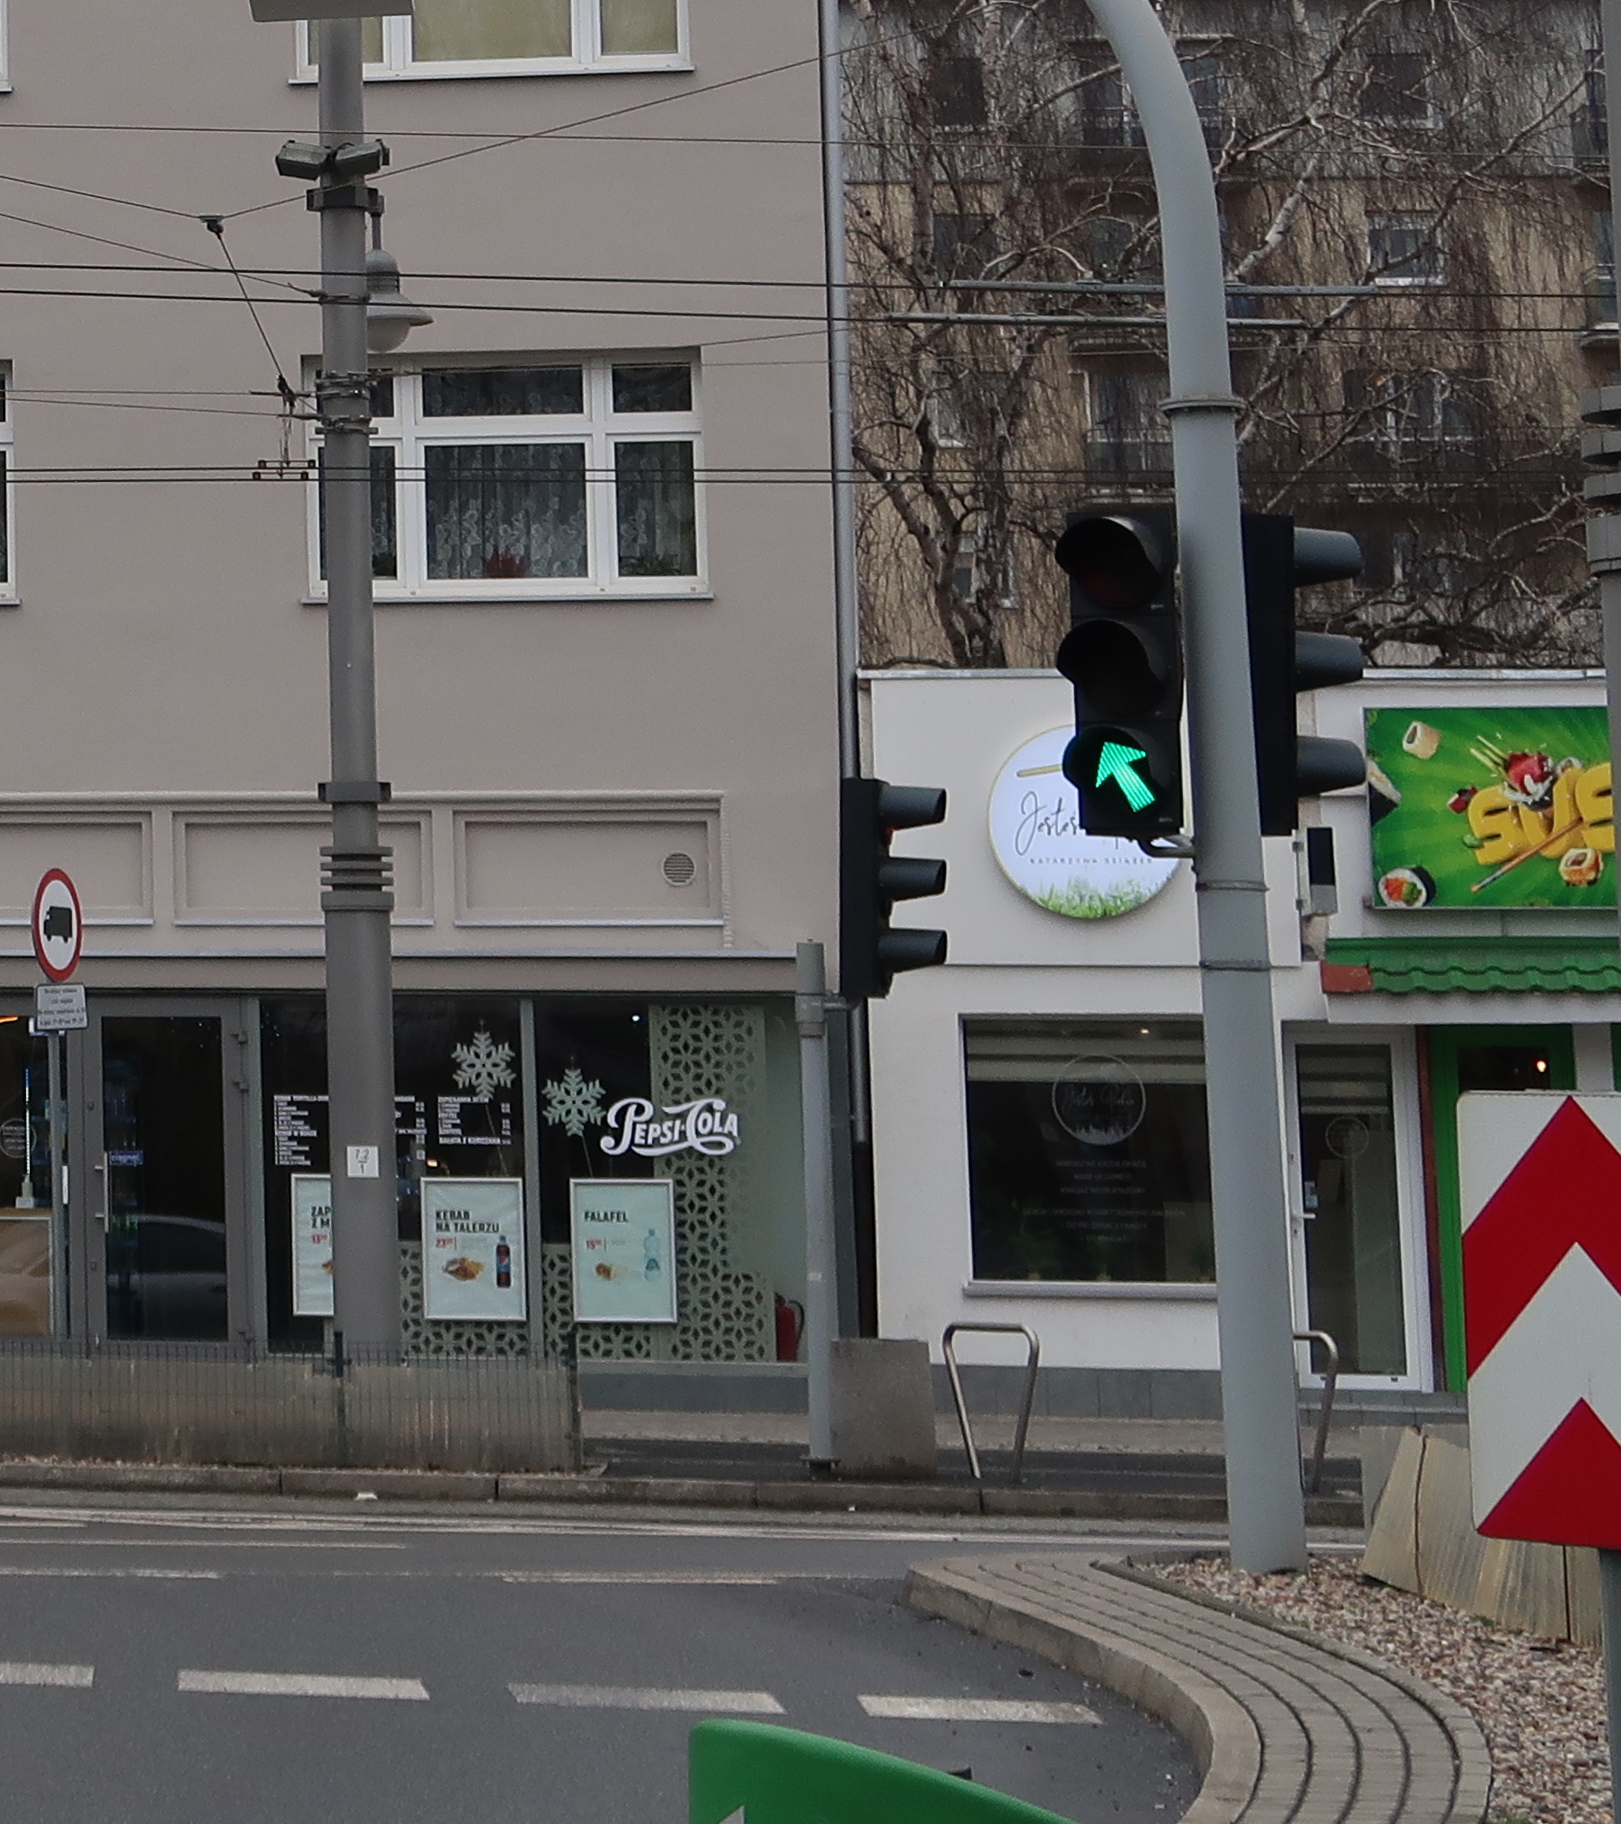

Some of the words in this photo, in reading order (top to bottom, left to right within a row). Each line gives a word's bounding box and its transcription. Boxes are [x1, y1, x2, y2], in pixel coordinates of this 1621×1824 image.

[436, 1210, 470, 1221] KEBAB
[584, 1211, 629, 1223] FALAFEL
[436, 1222, 451, 1233] NA
[454, 1222, 499, 1234] TALERZU
